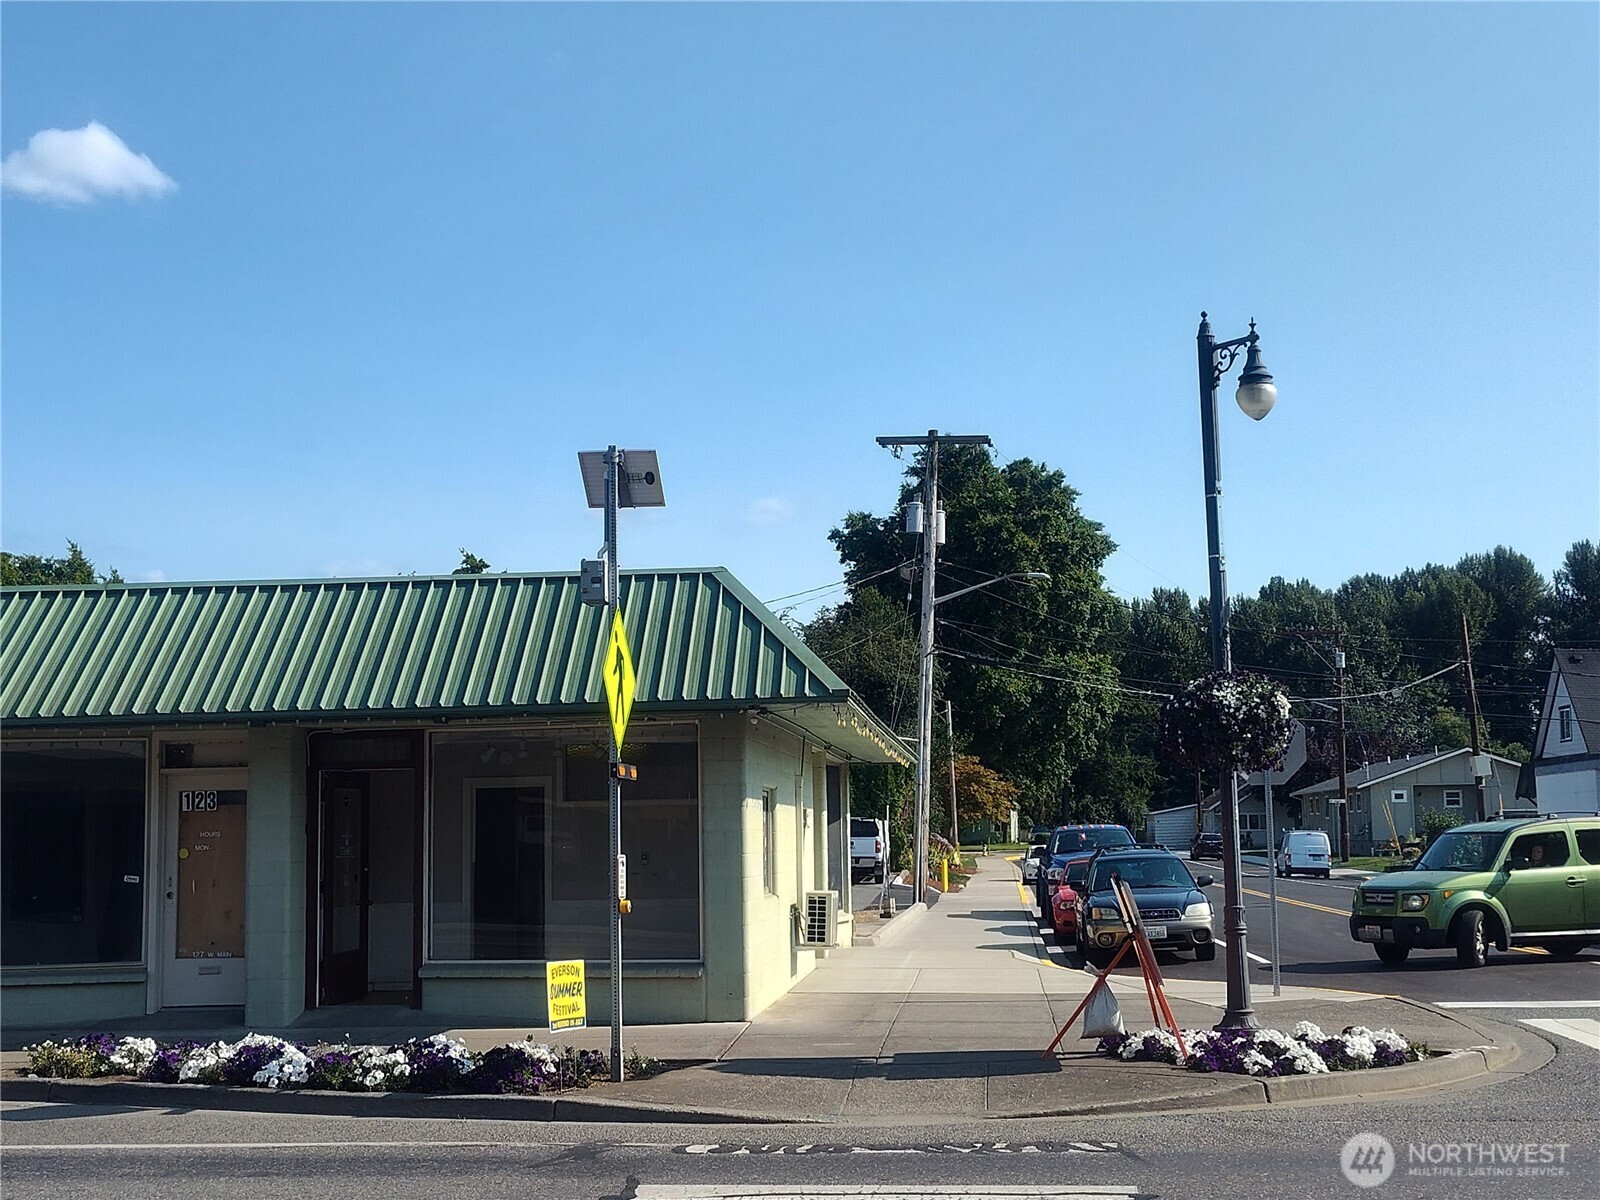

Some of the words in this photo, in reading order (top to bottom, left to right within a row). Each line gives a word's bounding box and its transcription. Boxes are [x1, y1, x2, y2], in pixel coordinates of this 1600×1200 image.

[182, 789, 217, 811] 123
[551, 964, 580, 980] EVERSON
[550, 981, 583, 1000] SUMMER
[552, 1001, 581, 1016] FESTIVAL
